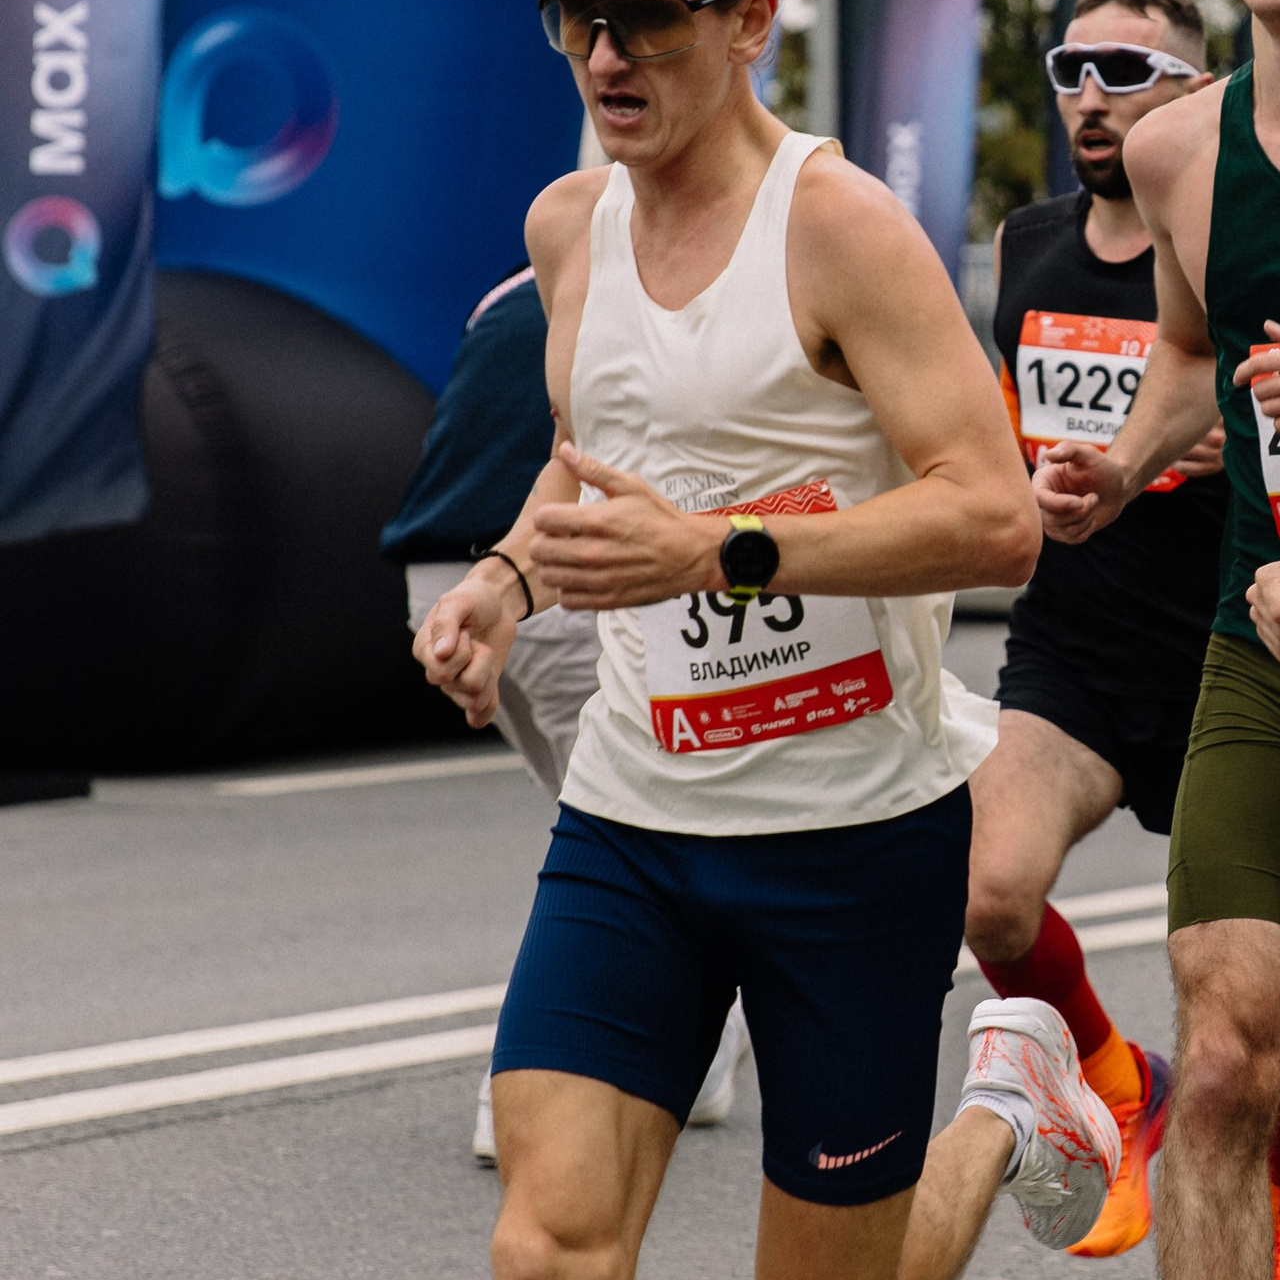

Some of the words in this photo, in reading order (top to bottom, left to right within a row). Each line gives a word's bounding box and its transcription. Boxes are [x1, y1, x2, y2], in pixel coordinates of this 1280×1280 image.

[665, 472, 736, 495] RUNNING
[673, 489, 739, 513] ELIGION
[690, 641, 812, 682] ВЛАДИМИР
[671, 707, 702, 752] A
